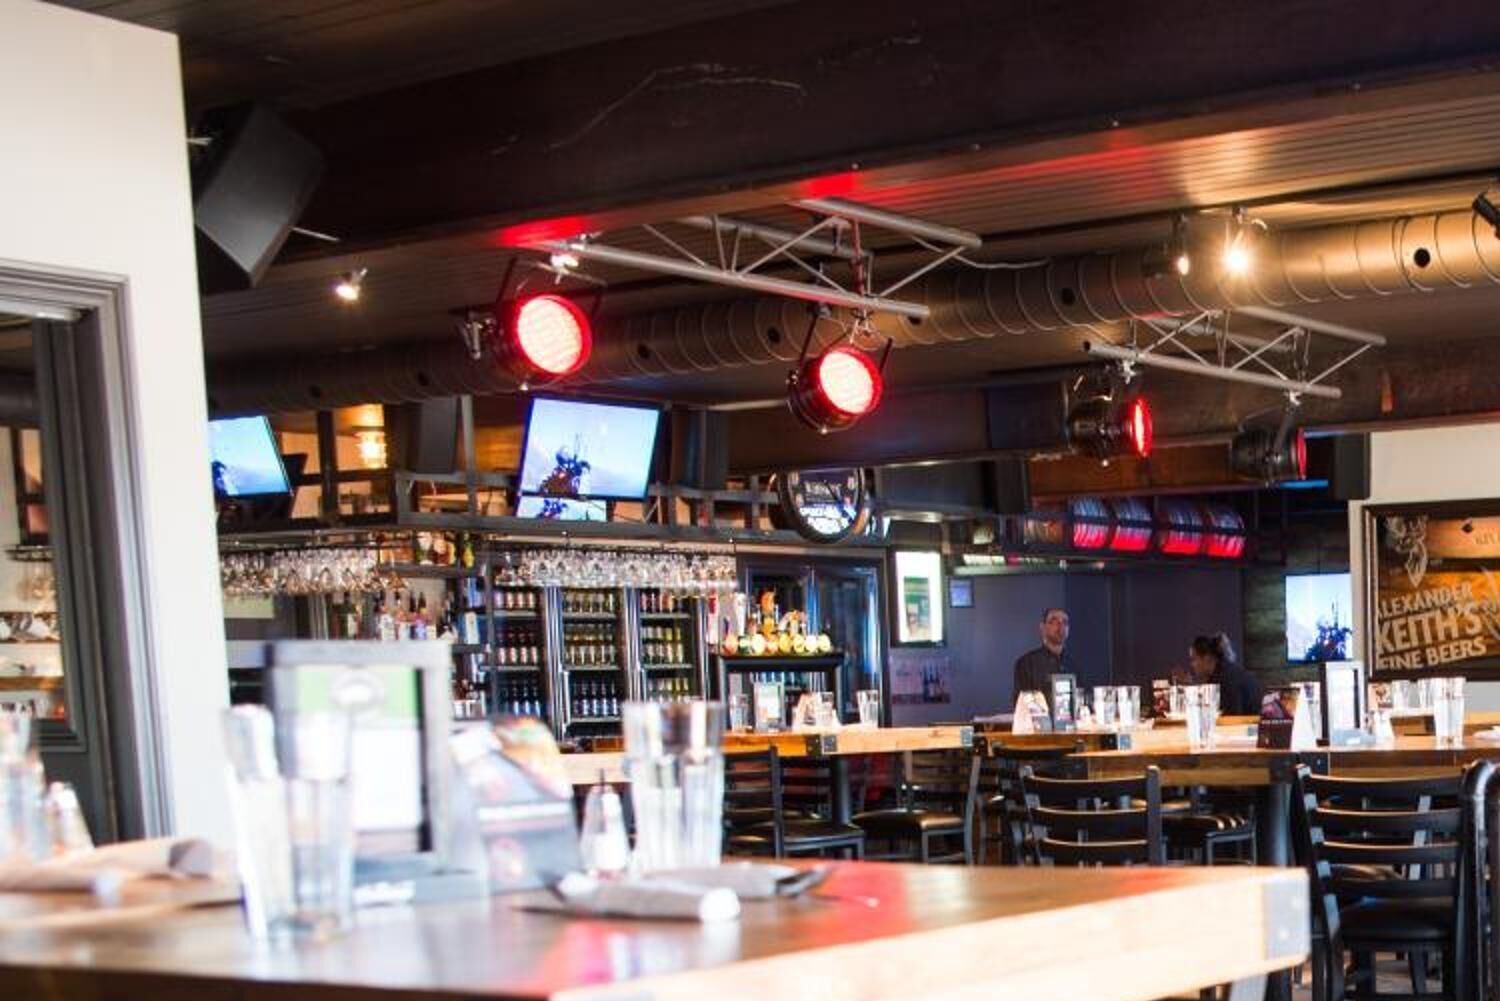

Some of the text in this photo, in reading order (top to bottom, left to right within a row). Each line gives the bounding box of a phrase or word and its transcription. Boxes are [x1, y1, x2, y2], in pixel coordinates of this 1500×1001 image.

[1376, 602, 1483, 655] KEITH'S
[1376, 636, 1488, 671] FINE BEERS
